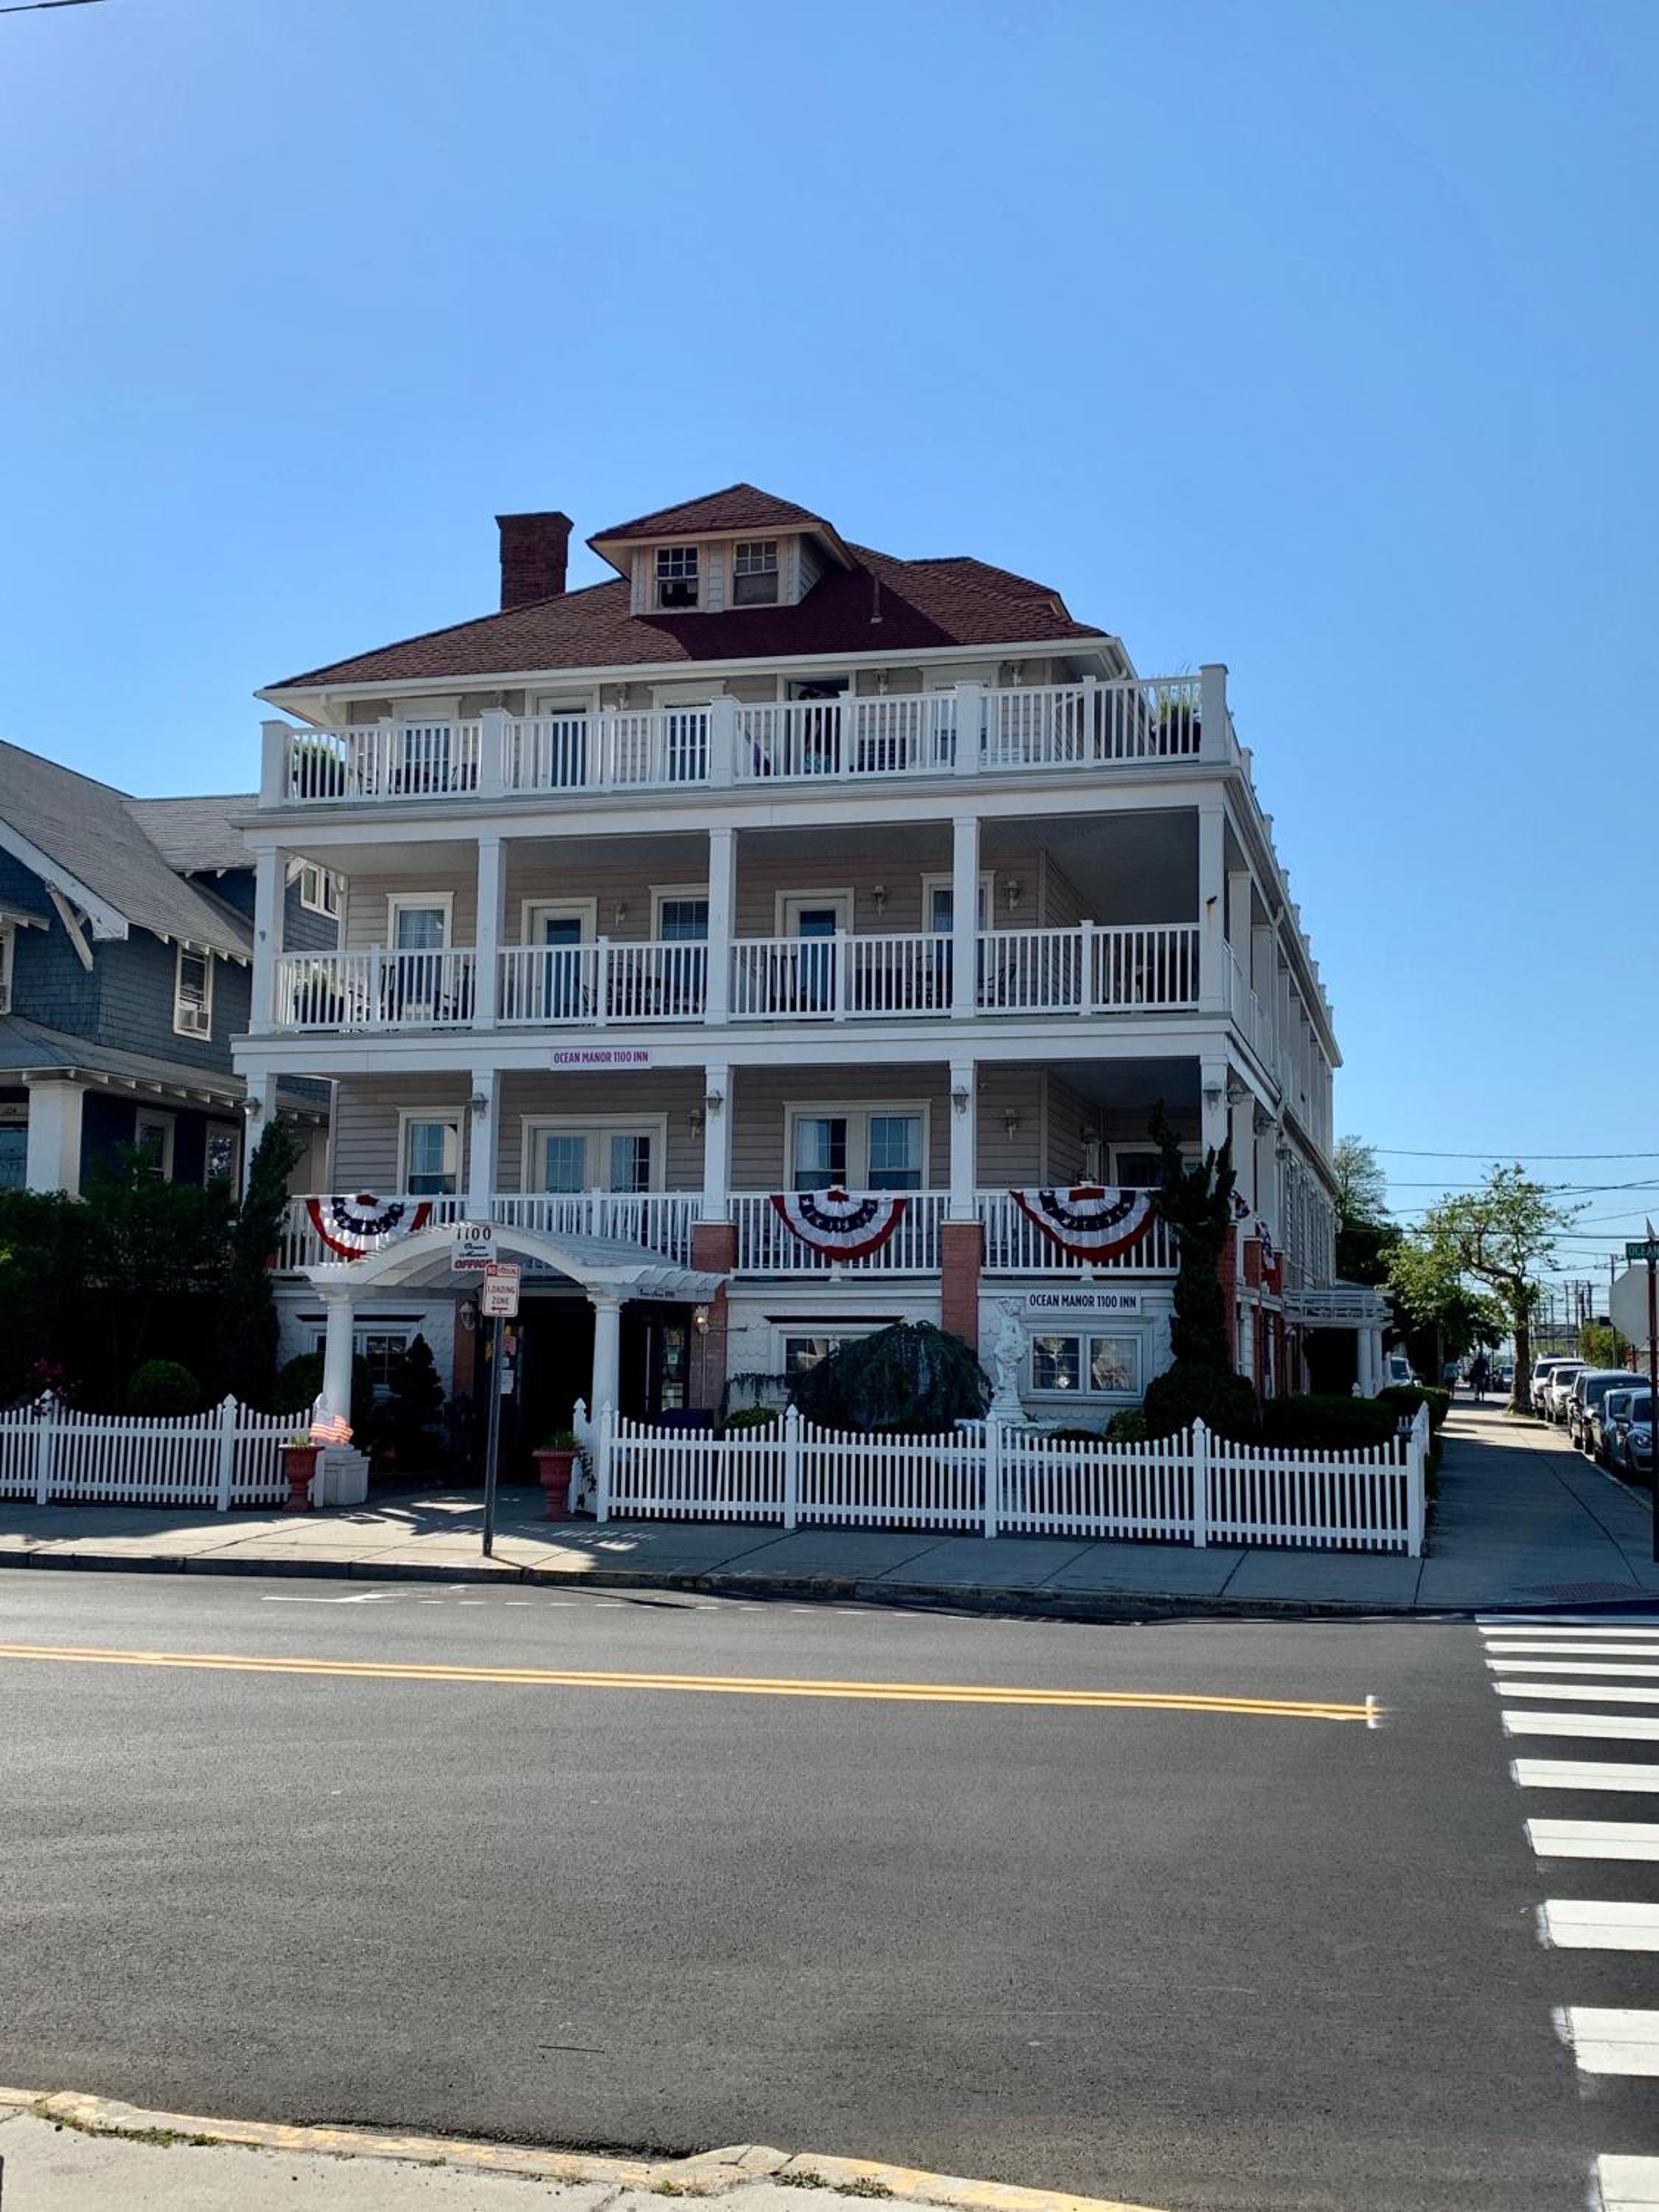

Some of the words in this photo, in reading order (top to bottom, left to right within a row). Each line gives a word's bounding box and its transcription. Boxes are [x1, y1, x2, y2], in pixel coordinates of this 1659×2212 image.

[554, 1052, 580, 1063] OCEAN
[582, 1051, 611, 1062] MANOR
[613, 1051, 632, 1062] 1100
[633, 1051, 648, 1062] INN
[457, 1227, 491, 1241] 1100
[488, 1285, 515, 1294] LOADING
[492, 1295, 509, 1304] ZONE
[1029, 1294, 1060, 1307] OCEAN
[1061, 1295, 1095, 1307] MANOR
[1096, 1295, 1117, 1307] 1100
[1120, 1295, 1136, 1308] INN
